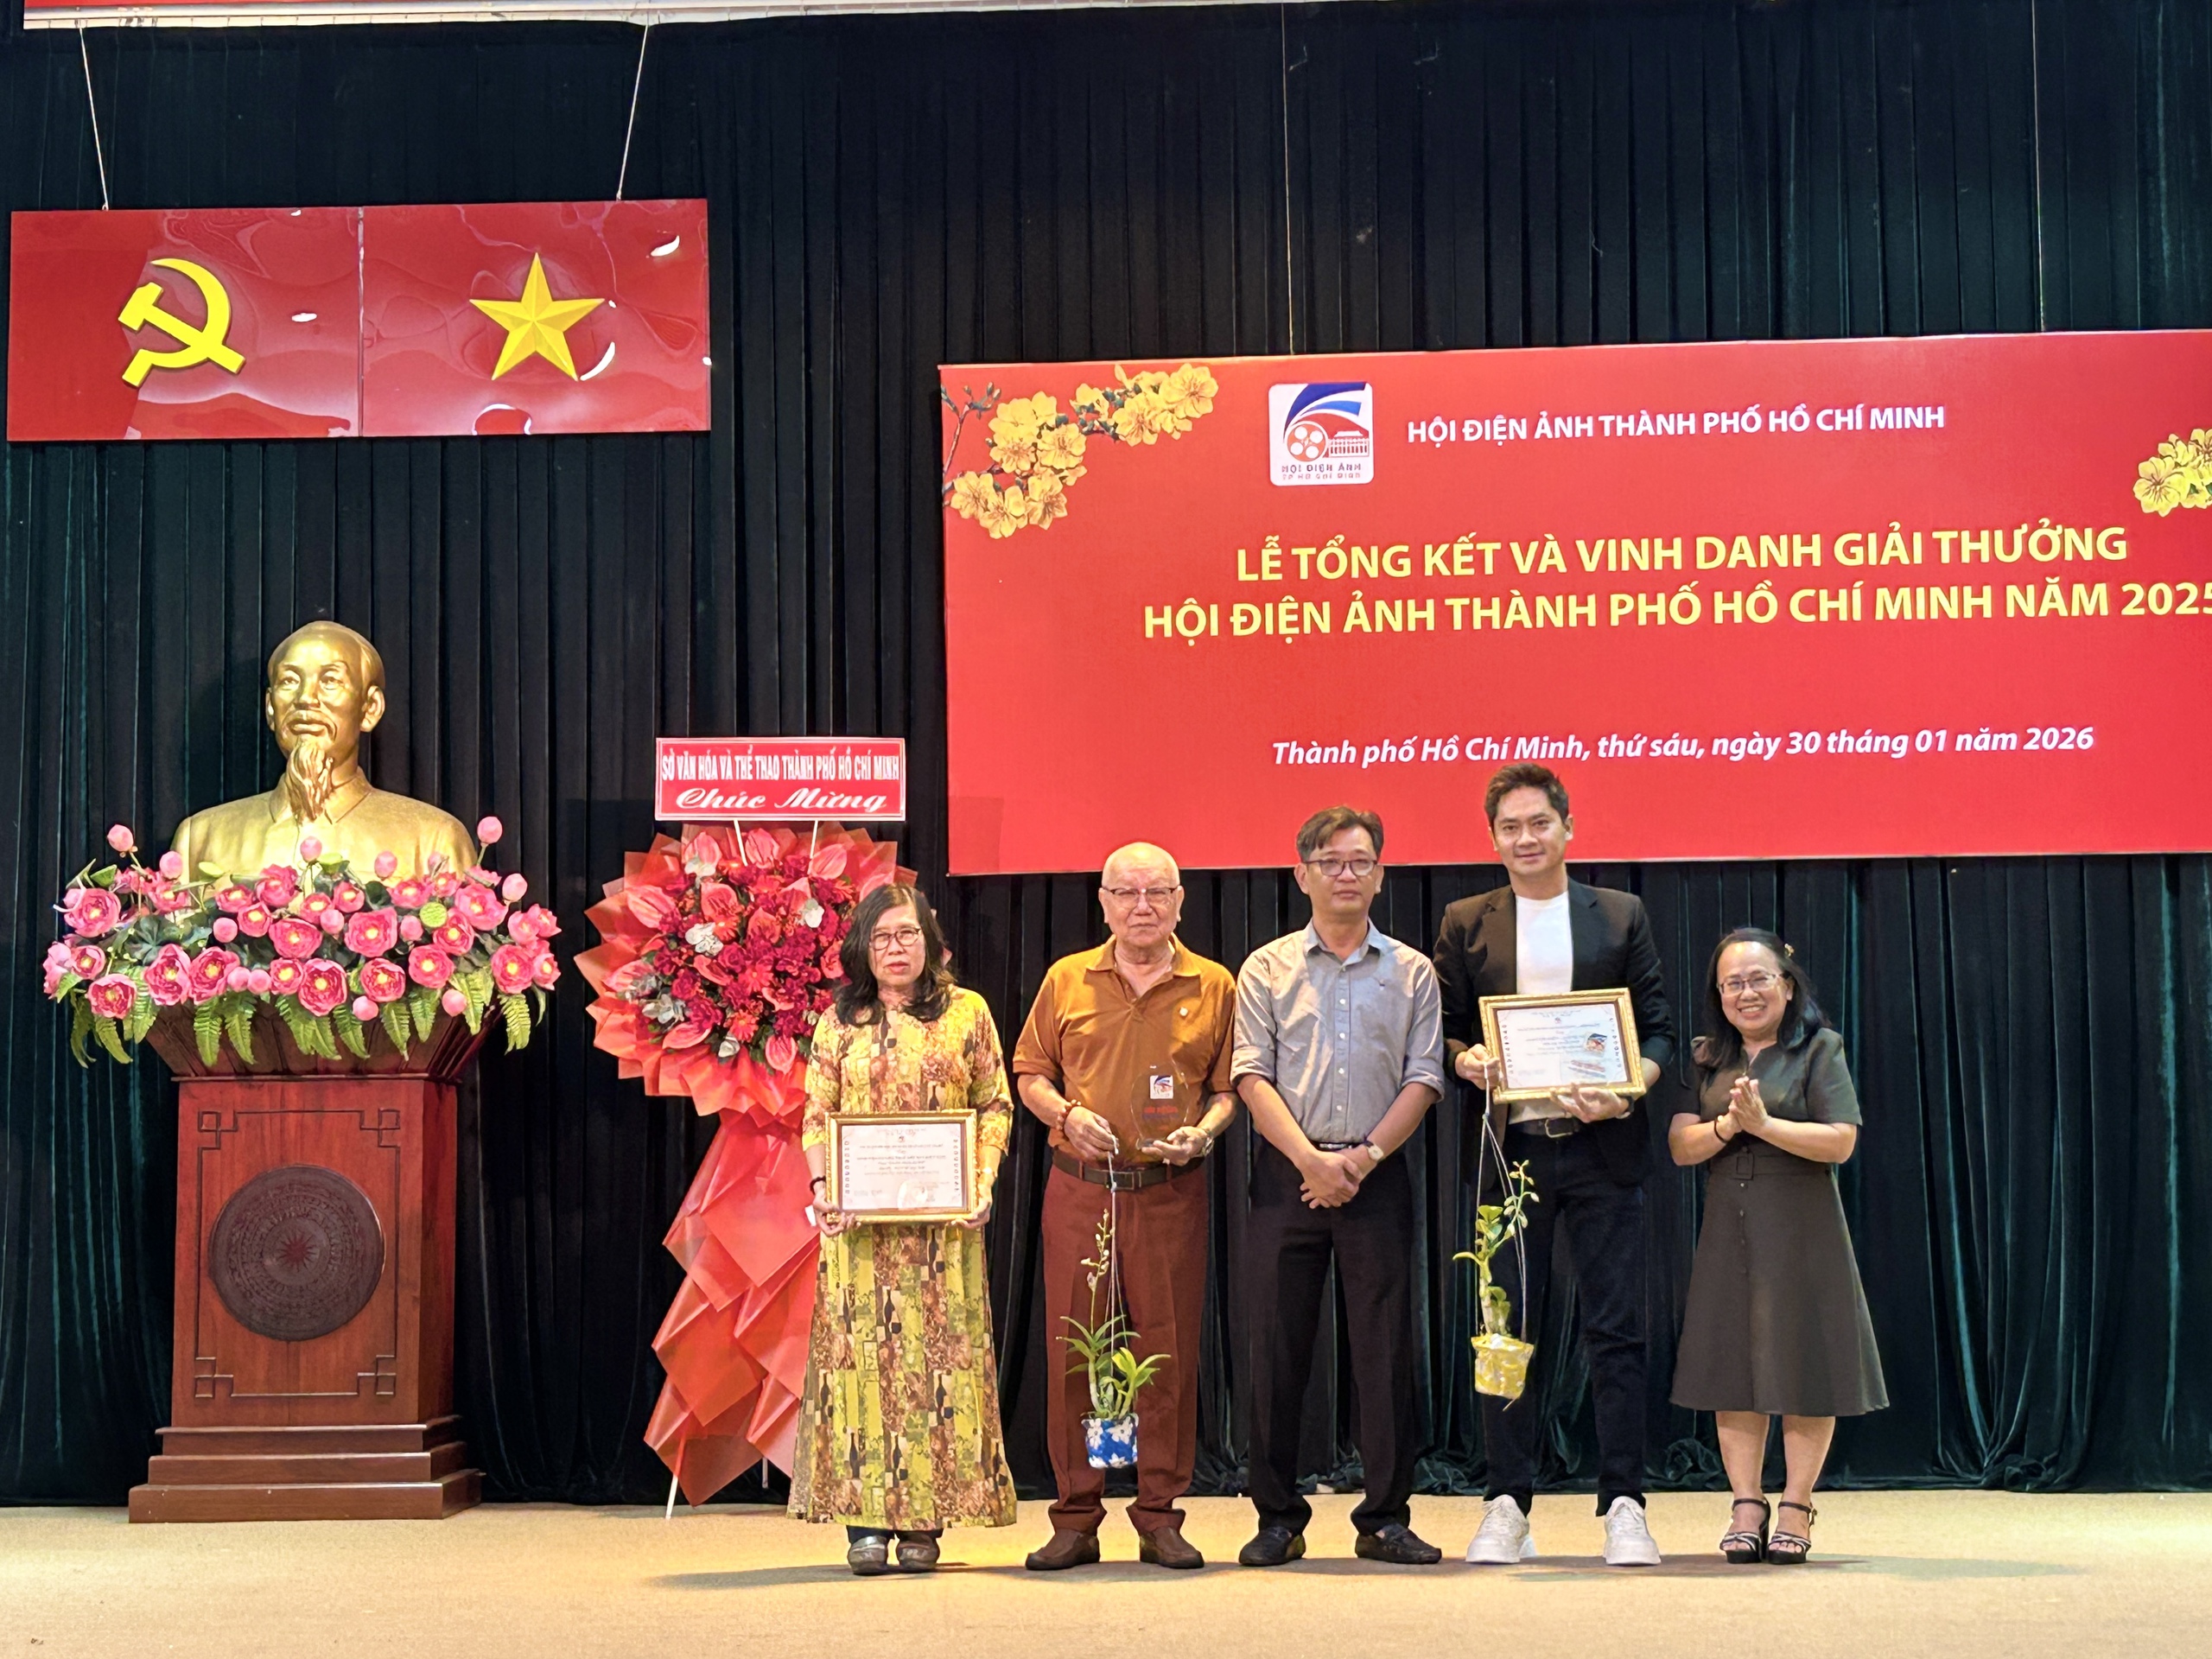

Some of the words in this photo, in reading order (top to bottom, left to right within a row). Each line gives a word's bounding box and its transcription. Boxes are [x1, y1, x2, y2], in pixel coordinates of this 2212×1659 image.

[1408, 416, 1456, 448] HỘI
[1461, 414, 1528, 447] ĐIỆN
[1535, 410, 1594, 439] ẢNH
[1598, 410, 1696, 437] THÀNH
[1703, 404, 1763, 435] PHỐ
[1769, 403, 1811, 433] HỒ
[1815, 403, 1865, 431] CHÍ
[1869, 405, 1945, 430] MINH
[1237, 535, 1283, 582] LỄ
[1291, 534, 1412, 580] TỔNG
[1424, 531, 1502, 576] KẾT
[1510, 533, 1567, 574] VÀ
[1575, 537, 1682, 572] VINH
[1695, 533, 1821, 570] DANH
[1834, 521, 1923, 567] GIẢI
[1931, 517, 2127, 564] THƯỞNG
[1144, 597, 1219, 647] HỘI
[1229, 594, 1331, 645] ĐIỆN
[1343, 589, 1435, 633] ẢNH
[1444, 588, 1597, 631] THÀNH
[1610, 581, 1702, 626] PHỐ
[1713, 579, 1778, 624] HỒ
[1789, 580, 1865, 623] CHÍ
[1875, 585, 1993, 621] MINH
[2005, 575, 2109, 618] NĂM
[662, 747, 676, 781] SỞ
[677, 751, 696, 780] VĂN
[698, 749, 718, 780] HÓA
[719, 749, 733, 780] VÀ
[734, 744, 753, 780] THỂ
[754, 755, 780, 780] THAO
[782, 749, 814, 780] THÀNH
[816, 746, 836, 781] PHỐ
[838, 746, 852, 780] HỒ
[854, 749, 872, 780] CHÍ
[874, 755, 899, 780] MINH
[1273, 739, 1357, 765] Thành
[1361, 735, 1418, 769] phố
[1421, 734, 1459, 762] Hồ
[1465, 735, 1511, 761] Chí
[1514, 734, 1591, 761] Minh,
[1598, 733, 1648, 758] thứ
[1649, 732, 1706, 760] sáu,
[1711, 731, 1782, 762] ngày
[1785, 731, 1821, 754] 30
[1826, 728, 1910, 759] tháng
[1915, 729, 1948, 753] 01
[1955, 727, 2018, 752] năm
[2023, 727, 2094, 750] 2026
[676, 787, 766, 810] Chúc
[773, 787, 887, 813] Mừng
